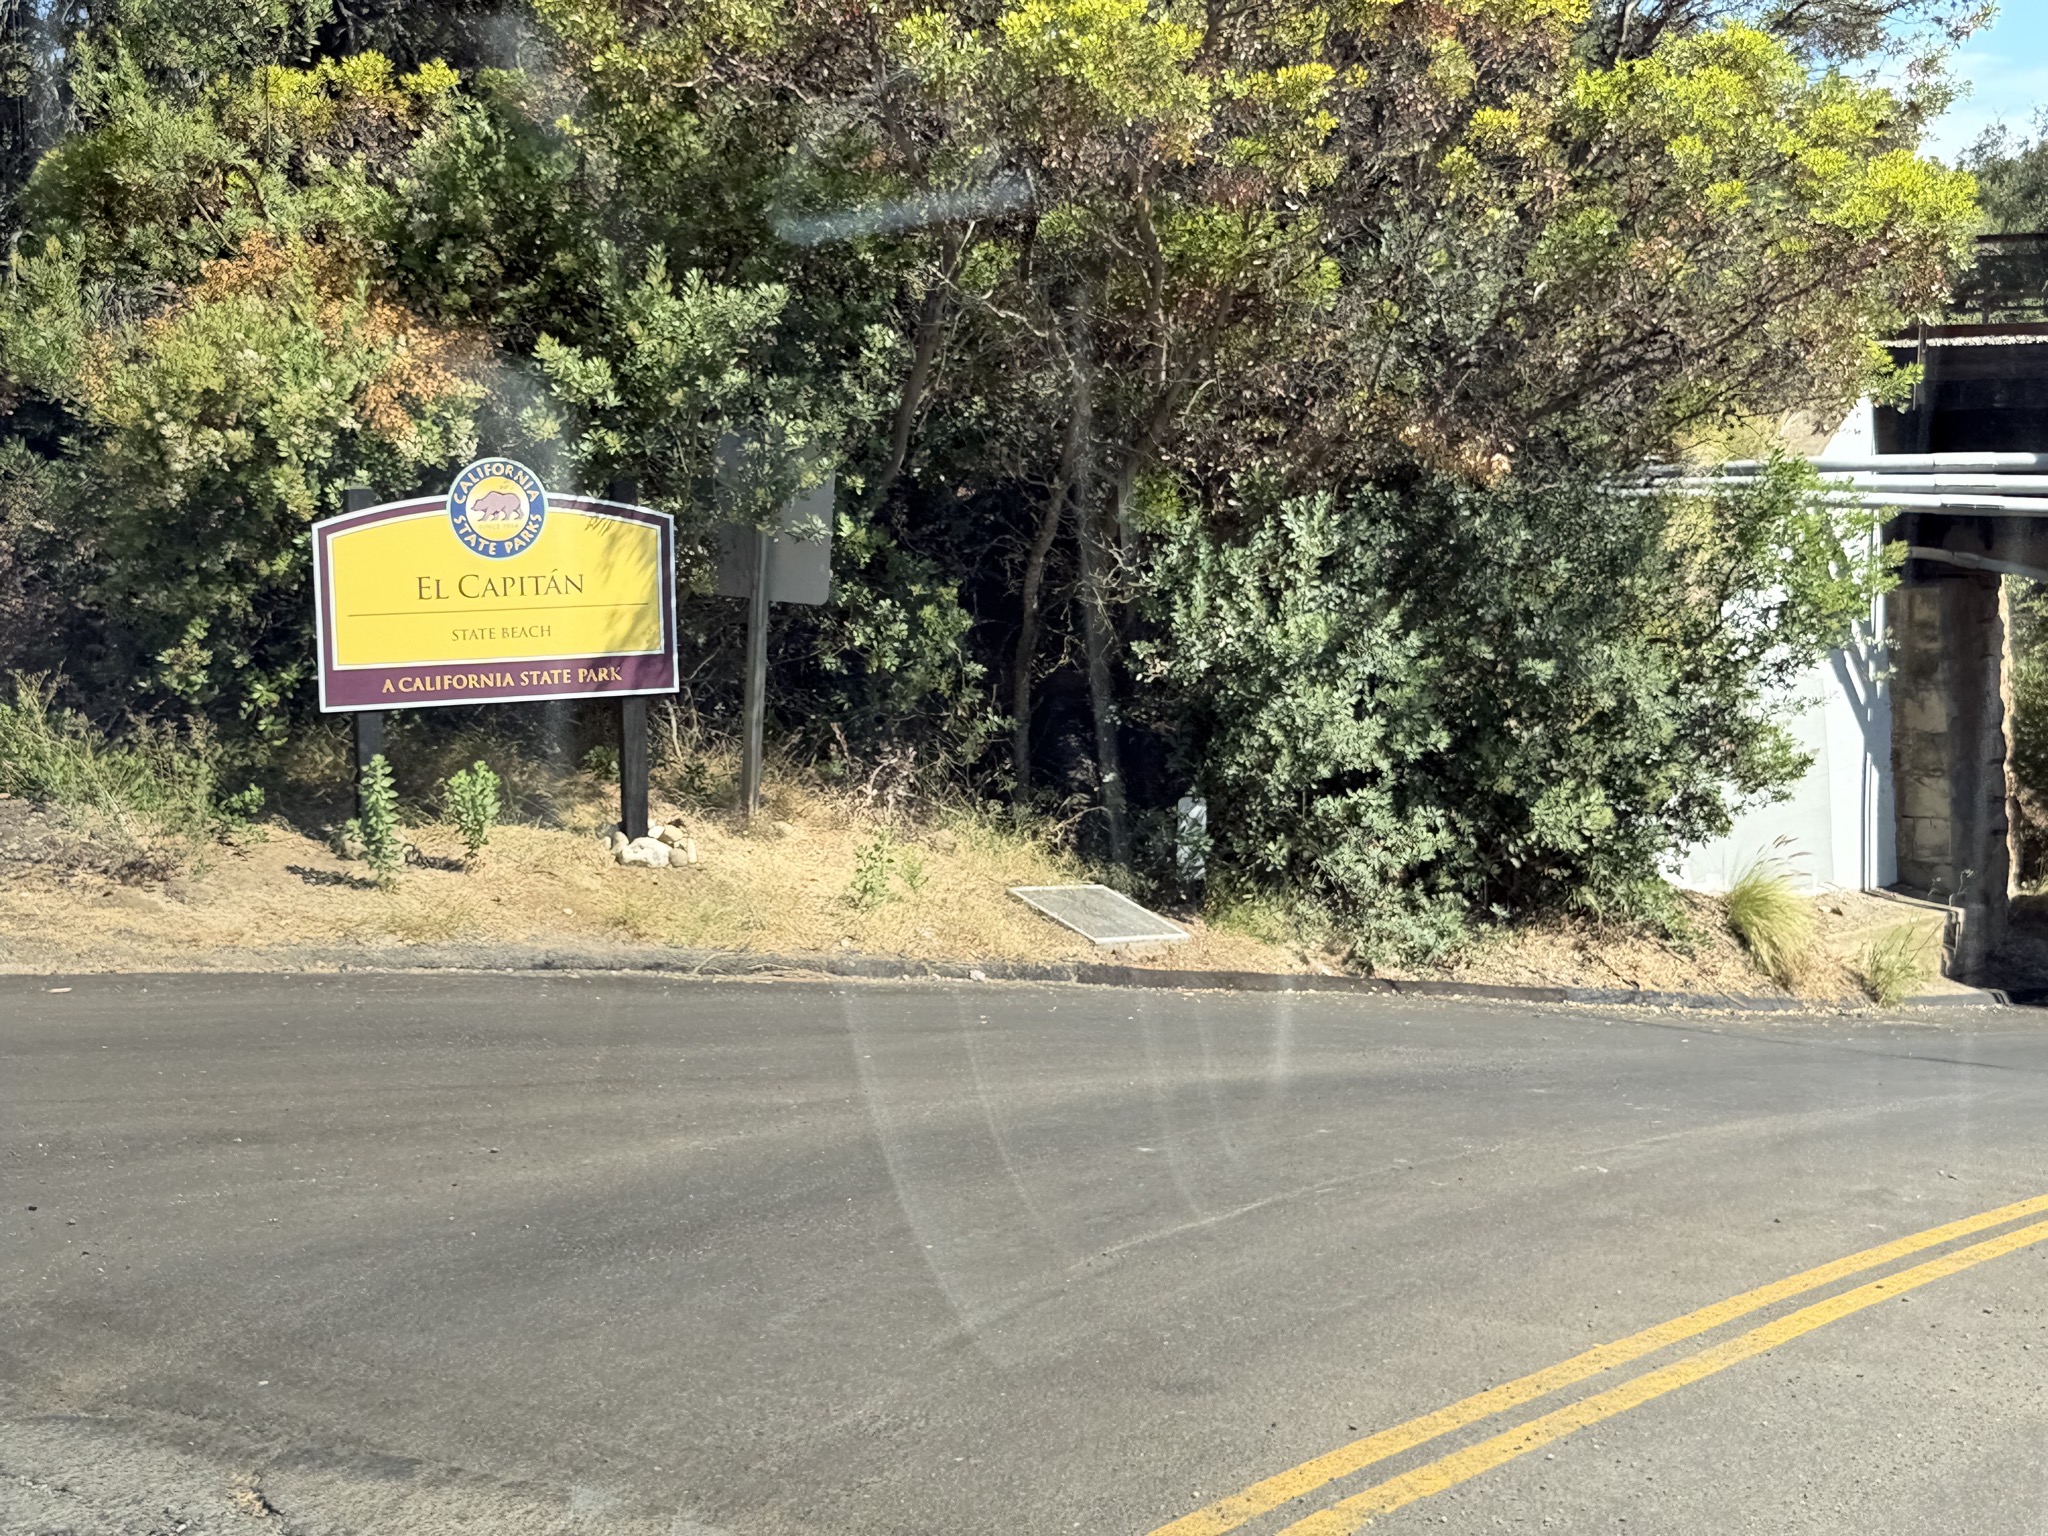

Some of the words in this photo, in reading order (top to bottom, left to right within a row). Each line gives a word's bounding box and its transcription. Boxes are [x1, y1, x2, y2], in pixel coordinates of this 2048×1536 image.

[453, 463, 540, 504] CALIFORNIA
[454, 515, 497, 555] STATE
[504, 514, 542, 553] PARKS
[451, 627, 496, 641] STATE
[501, 625, 551, 639] BEACH
[382, 679, 395, 693] A
[398, 673, 515, 692] CALIFORNIA
[520, 669, 571, 686] STATE
[578, 667, 622, 683] PARK
